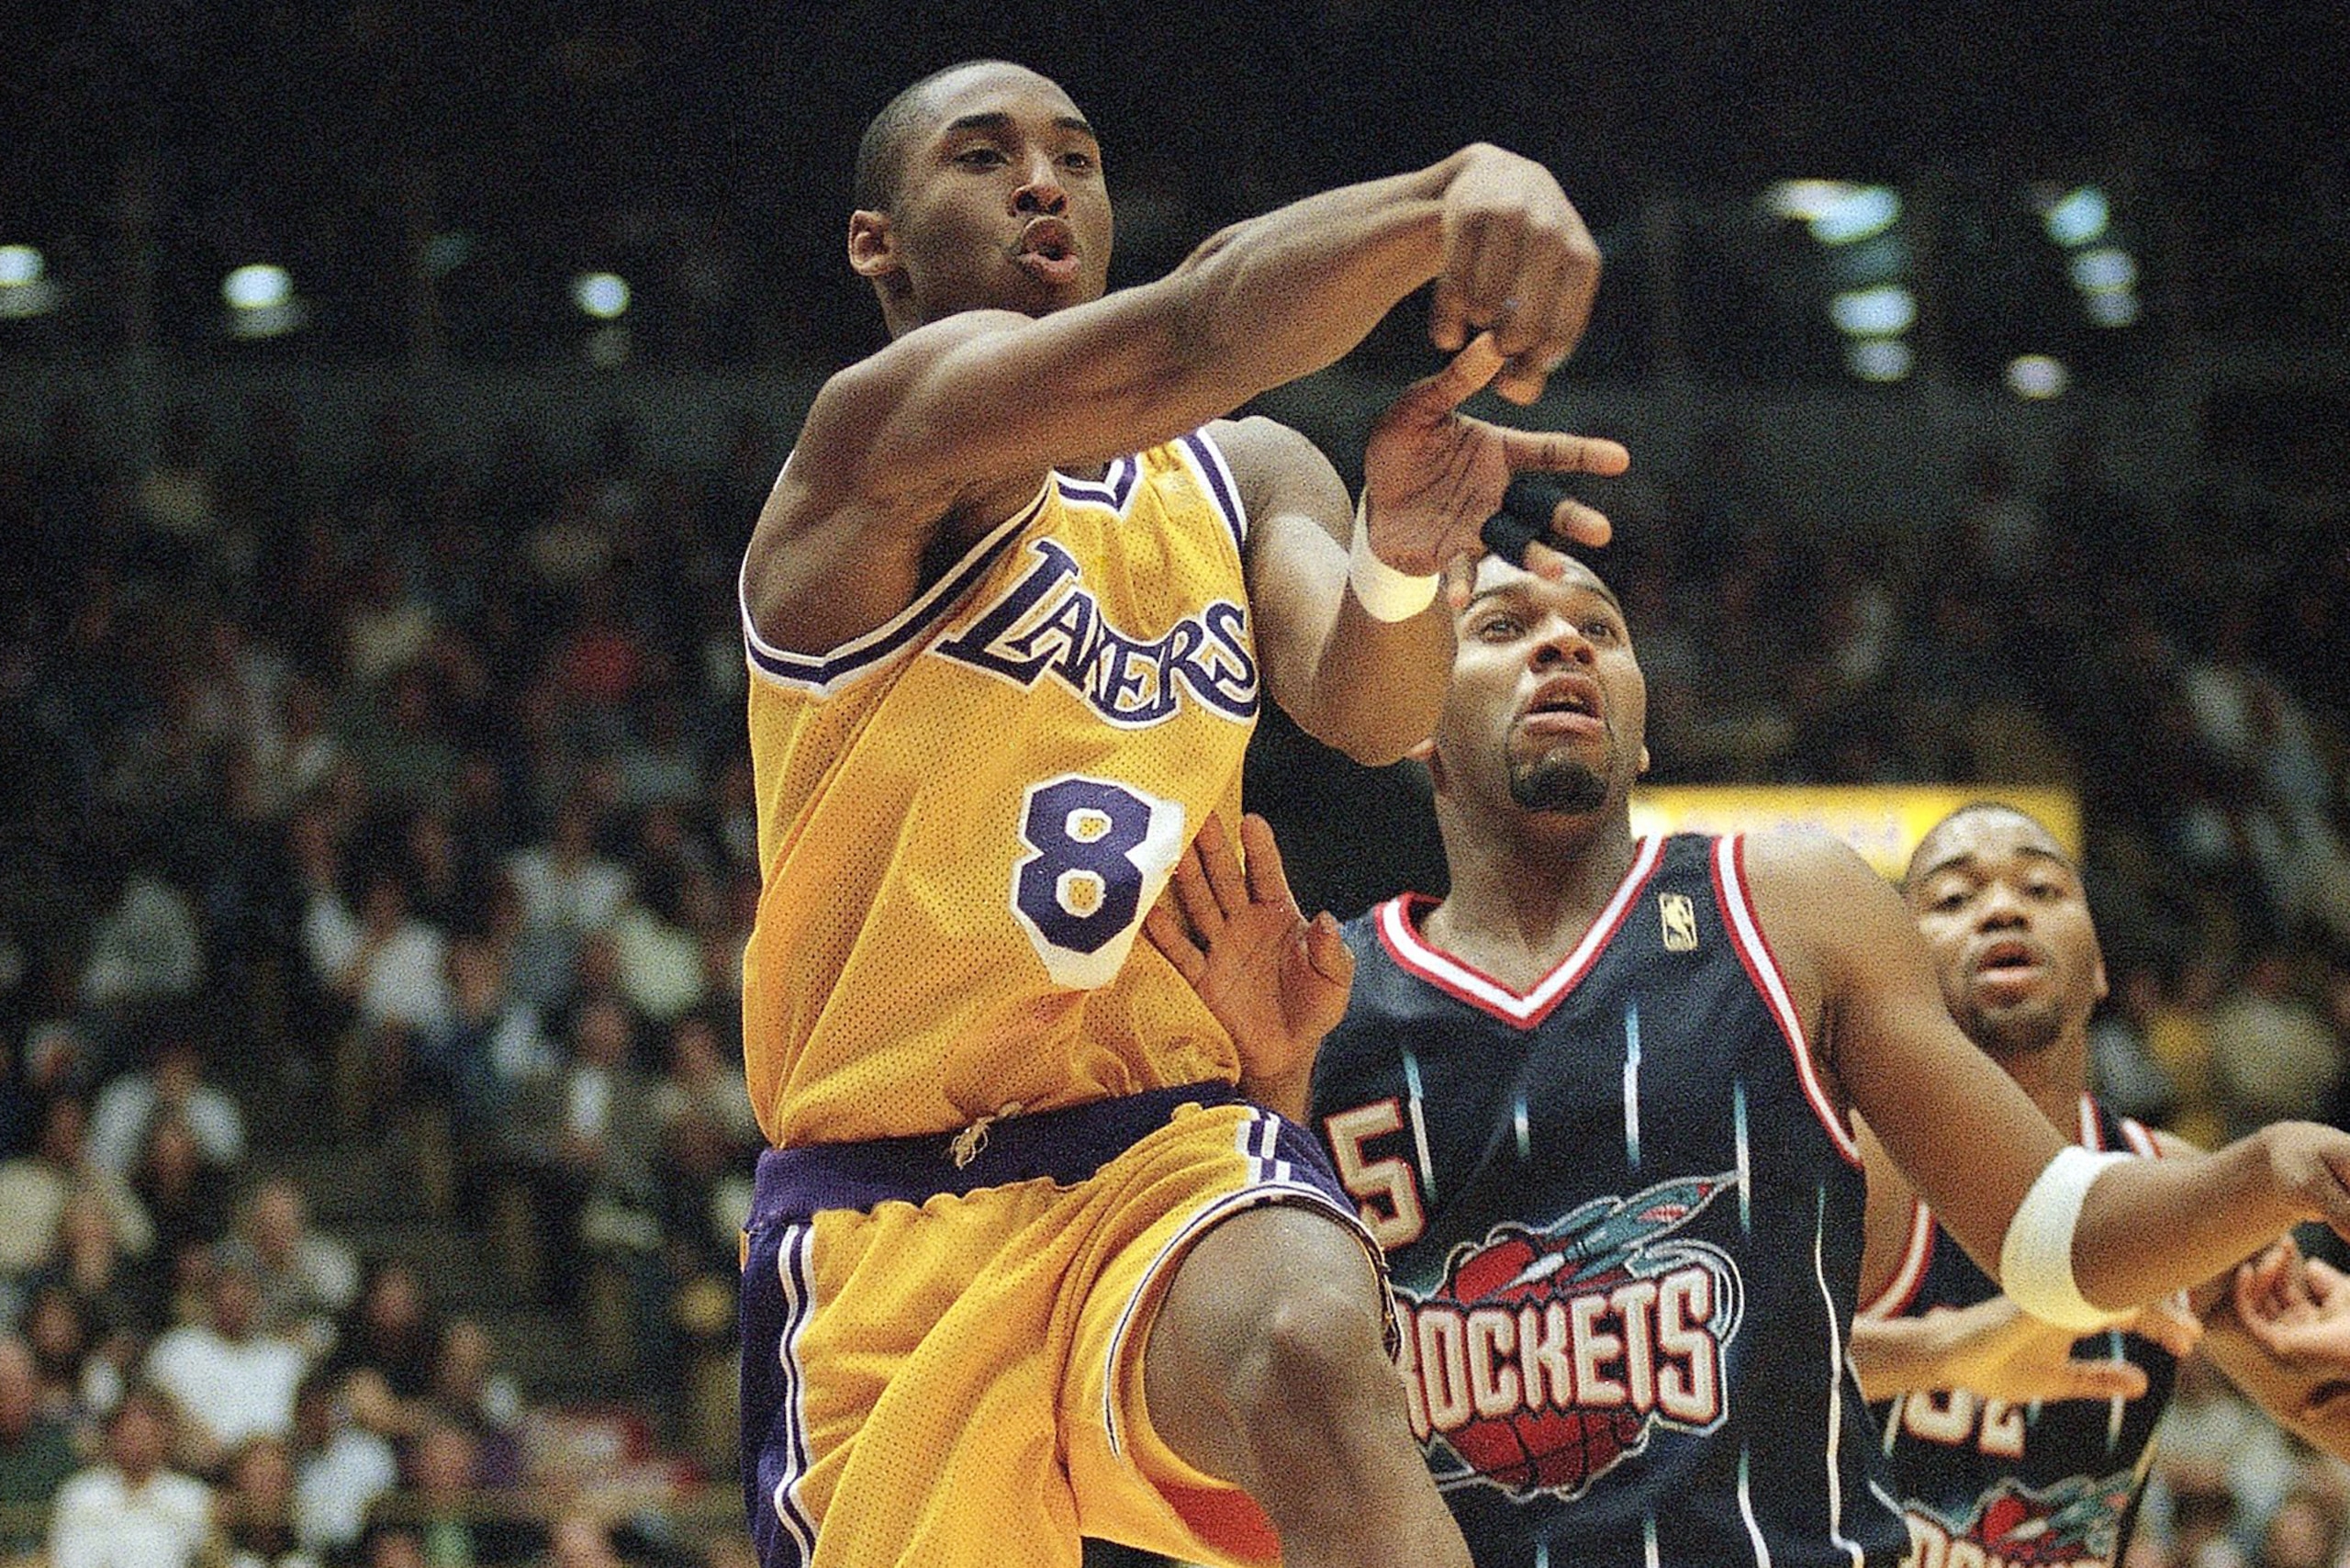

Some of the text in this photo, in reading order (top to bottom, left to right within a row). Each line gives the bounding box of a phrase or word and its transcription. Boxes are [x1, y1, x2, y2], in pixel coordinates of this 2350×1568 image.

[931, 536, 1260, 729] LAKERS
[1012, 774, 1161, 969] 8
[1323, 1096, 1427, 1252] 5
